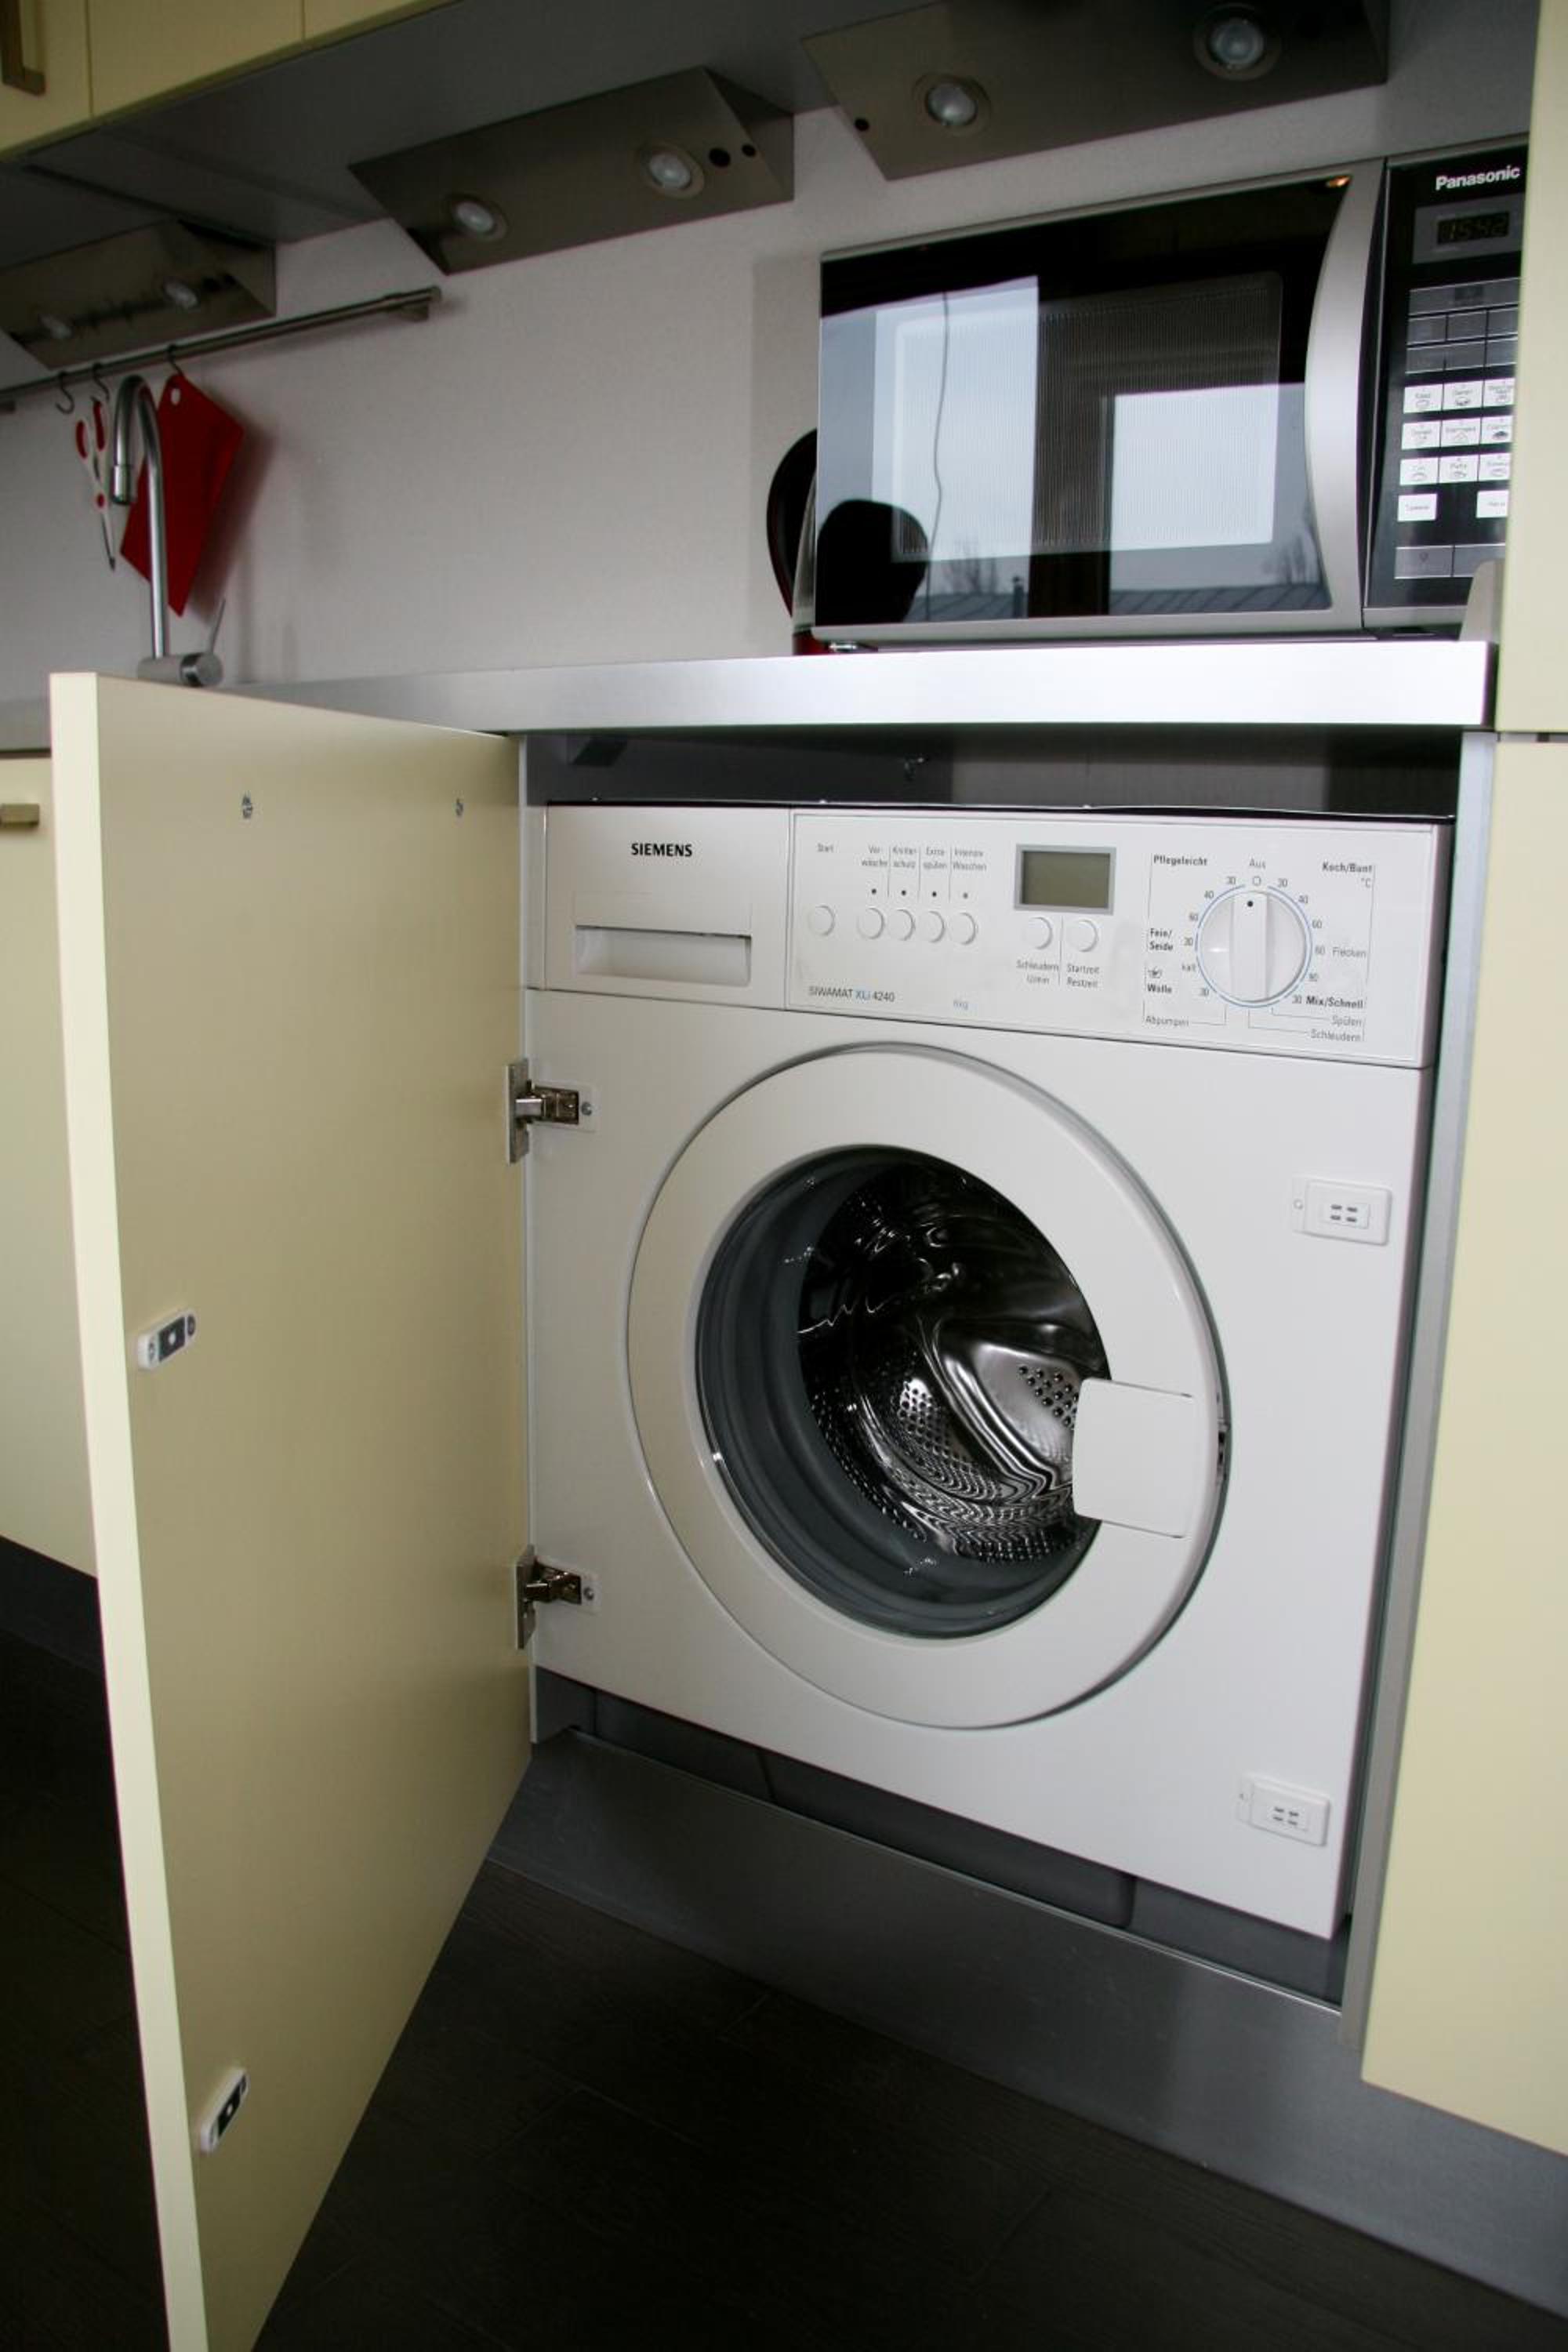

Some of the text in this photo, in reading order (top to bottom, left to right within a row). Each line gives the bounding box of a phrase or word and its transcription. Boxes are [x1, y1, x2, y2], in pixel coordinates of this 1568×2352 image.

[1436, 165, 1521, 191] Panasonic
[631, 843, 692, 857] SIEMENS
[1153, 855, 1207, 866] Pflegeleicht
[1249, 858, 1266, 869] Aus
[1323, 862, 1372, 873] Koch/Bunt
[1204, 890, 1214, 899] 40
[1150, 927, 1172, 938] Fein/
[1149, 941, 1173, 952] Seide
[1332, 946, 1367, 958] Flecken
[1067, 964, 1099, 975] Startzeit
[1067, 977, 1098, 988] Restzeit
[808, 985, 853, 998] SIWAMAT
[873, 991, 895, 1003] 4240
[1147, 983, 1172, 994] Wolle
[1305, 996, 1363, 1009] Mix/Schnell
[1145, 1015, 1189, 1028] Abpumpen
[1311, 1028, 1360, 1042] Schleudern
